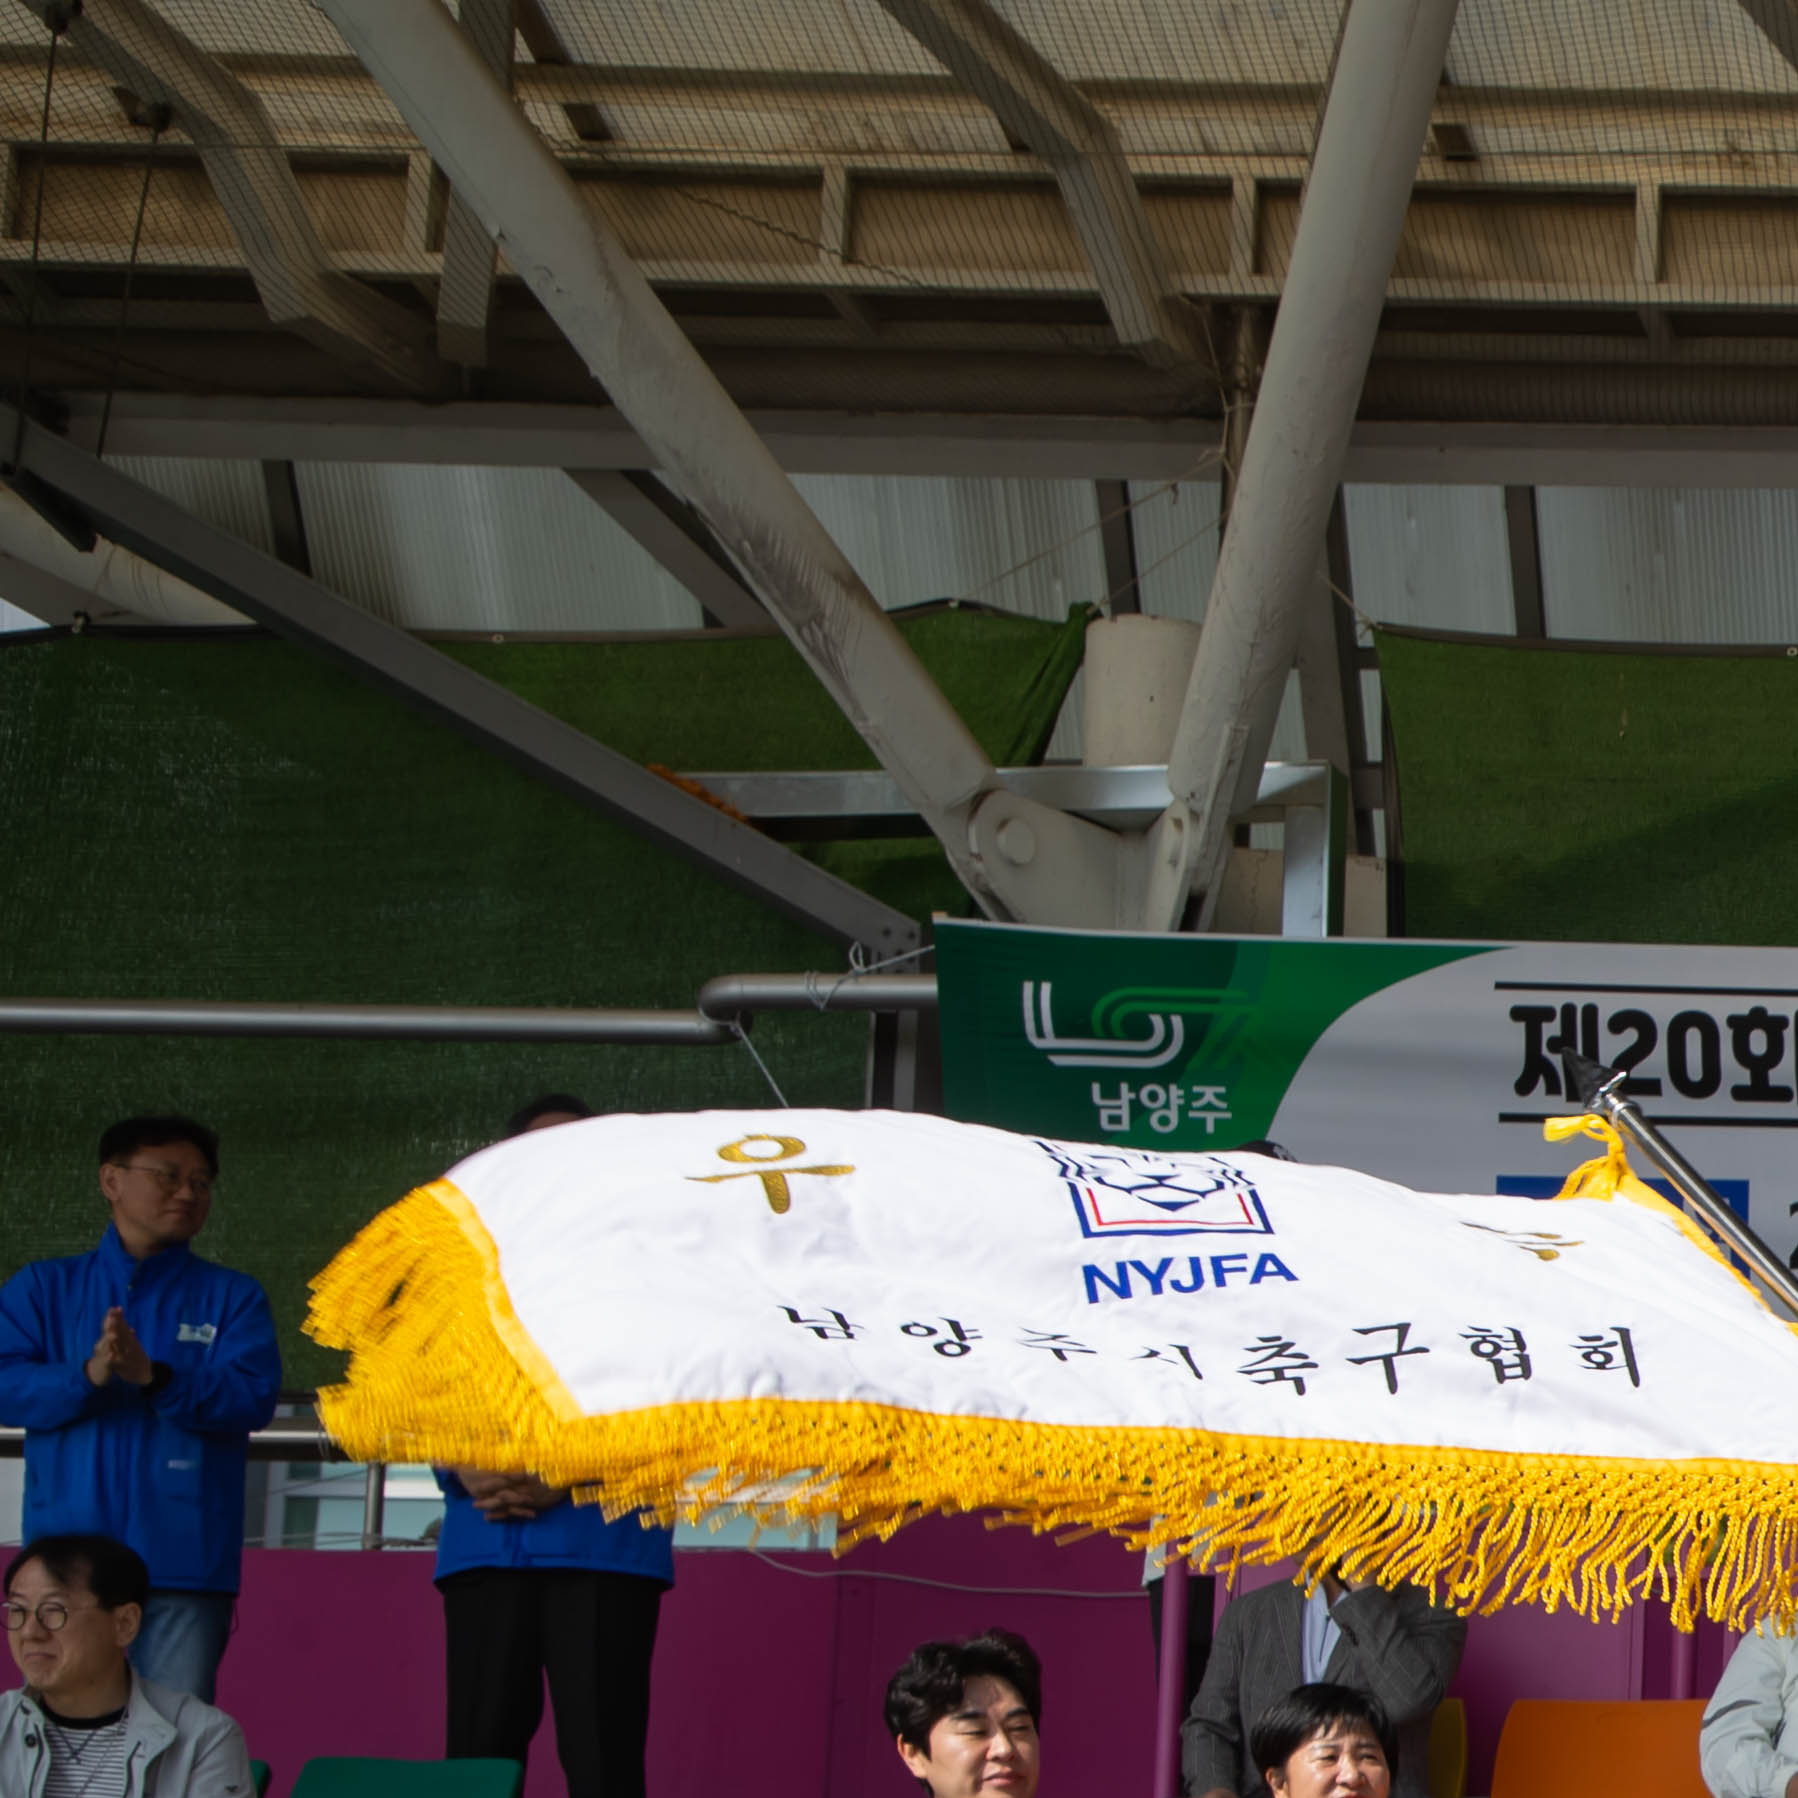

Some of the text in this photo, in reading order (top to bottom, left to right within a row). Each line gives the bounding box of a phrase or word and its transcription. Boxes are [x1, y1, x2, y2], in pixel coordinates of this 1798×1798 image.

[1091, 1082, 1232, 1133] 남양주
[685, 1133, 856, 1215] 우
[1082, 1252, 1299, 1304] NYJFA
